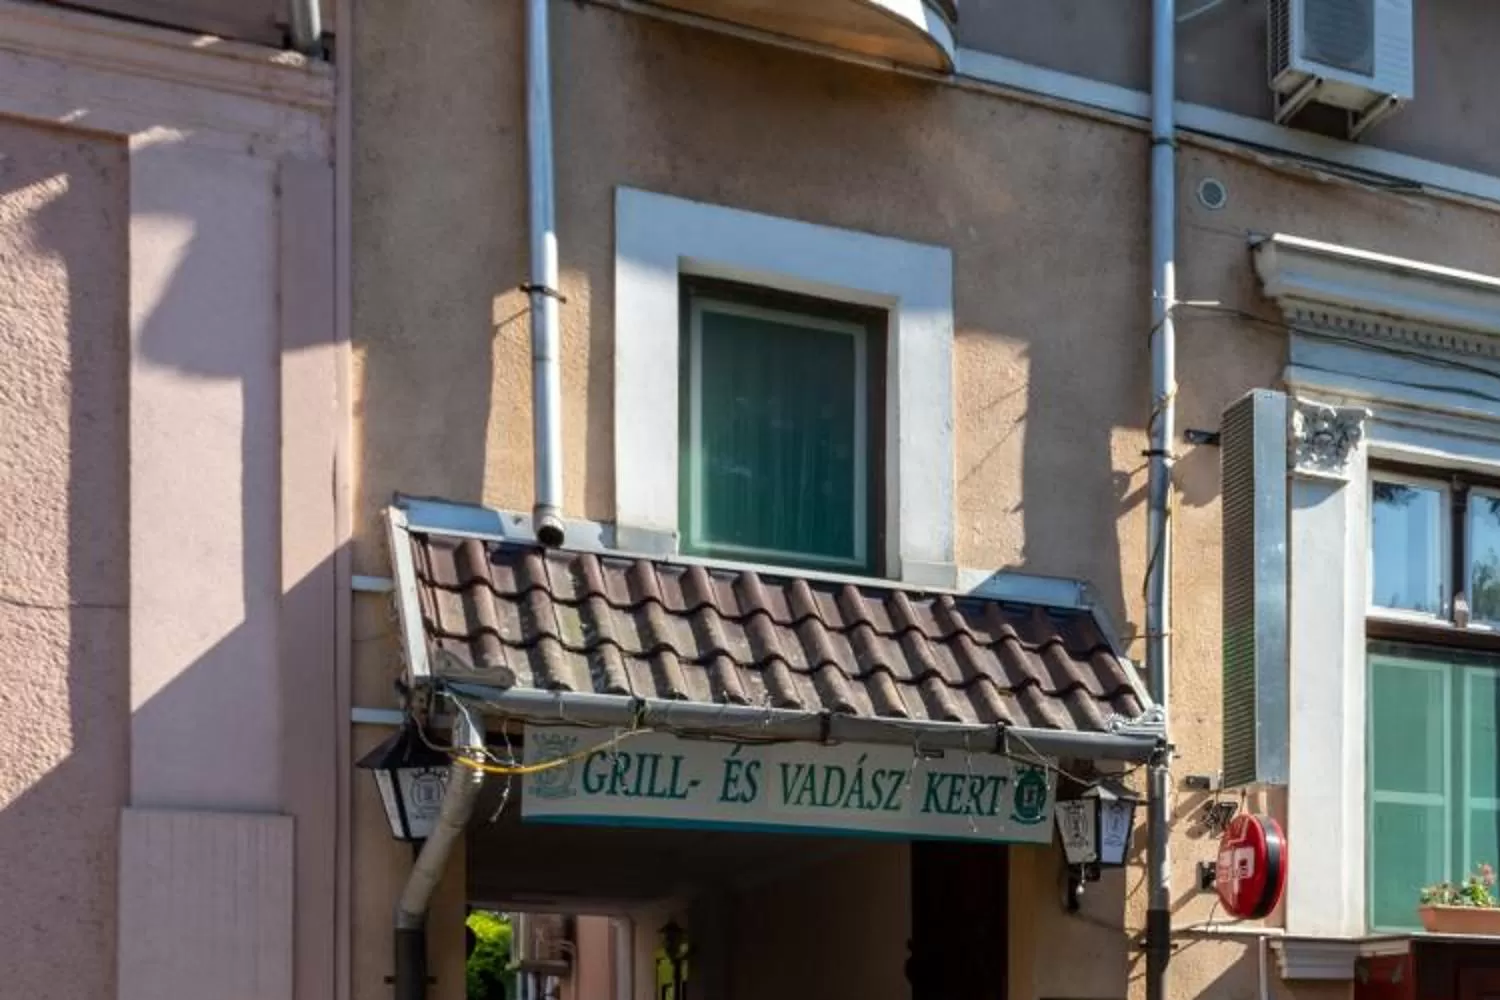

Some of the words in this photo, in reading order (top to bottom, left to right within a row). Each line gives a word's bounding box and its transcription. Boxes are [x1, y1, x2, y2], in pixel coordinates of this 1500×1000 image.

[582, 749, 702, 799] GRILL-
[719, 744, 761, 804] ÉS
[779, 753, 906, 811] VADÁSZ
[921, 771, 1008, 816] KERT
